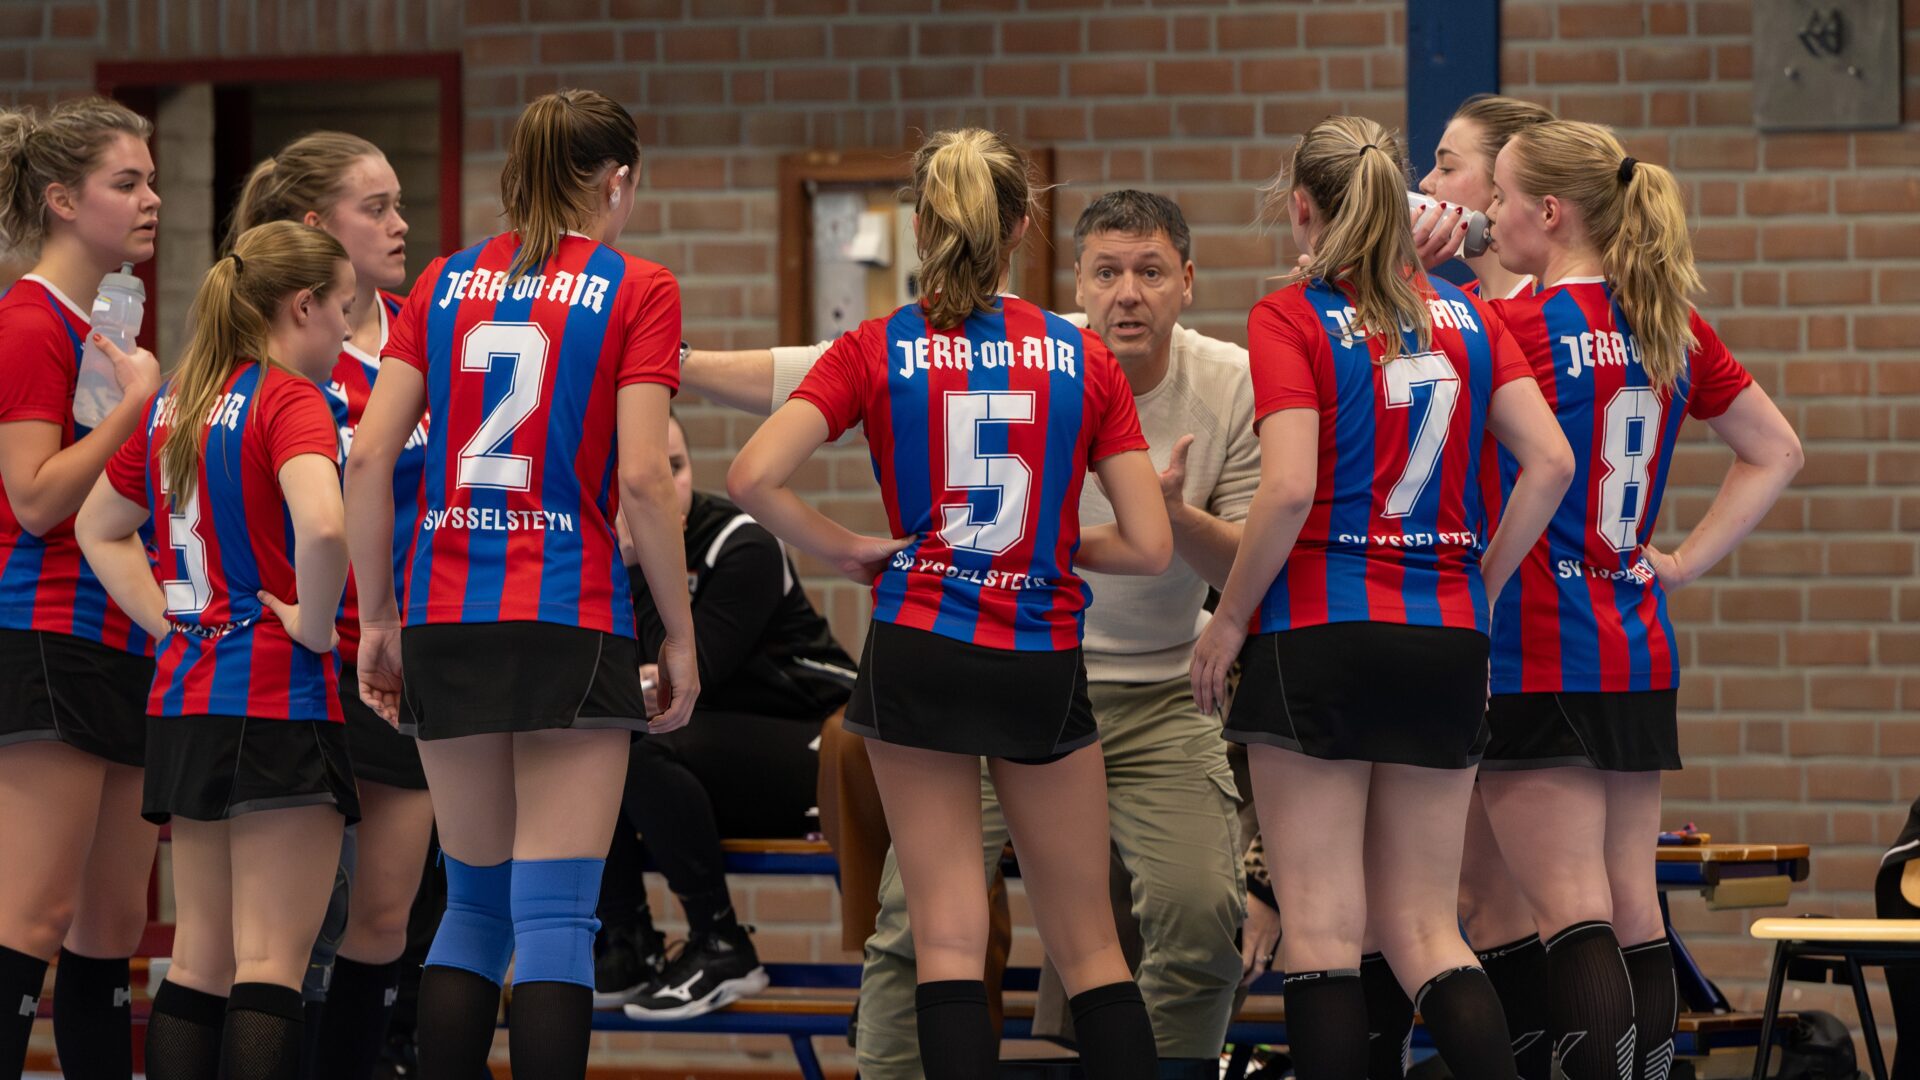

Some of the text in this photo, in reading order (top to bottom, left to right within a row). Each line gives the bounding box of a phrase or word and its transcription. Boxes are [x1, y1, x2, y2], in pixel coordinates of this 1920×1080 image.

[456, 321, 550, 492] 2
[936, 390, 1036, 556] 5
[1379, 350, 1461, 518] 7
[1597, 386, 1663, 553] 8
[160, 448, 213, 616] 3
[1558, 559, 1582, 579] SV
